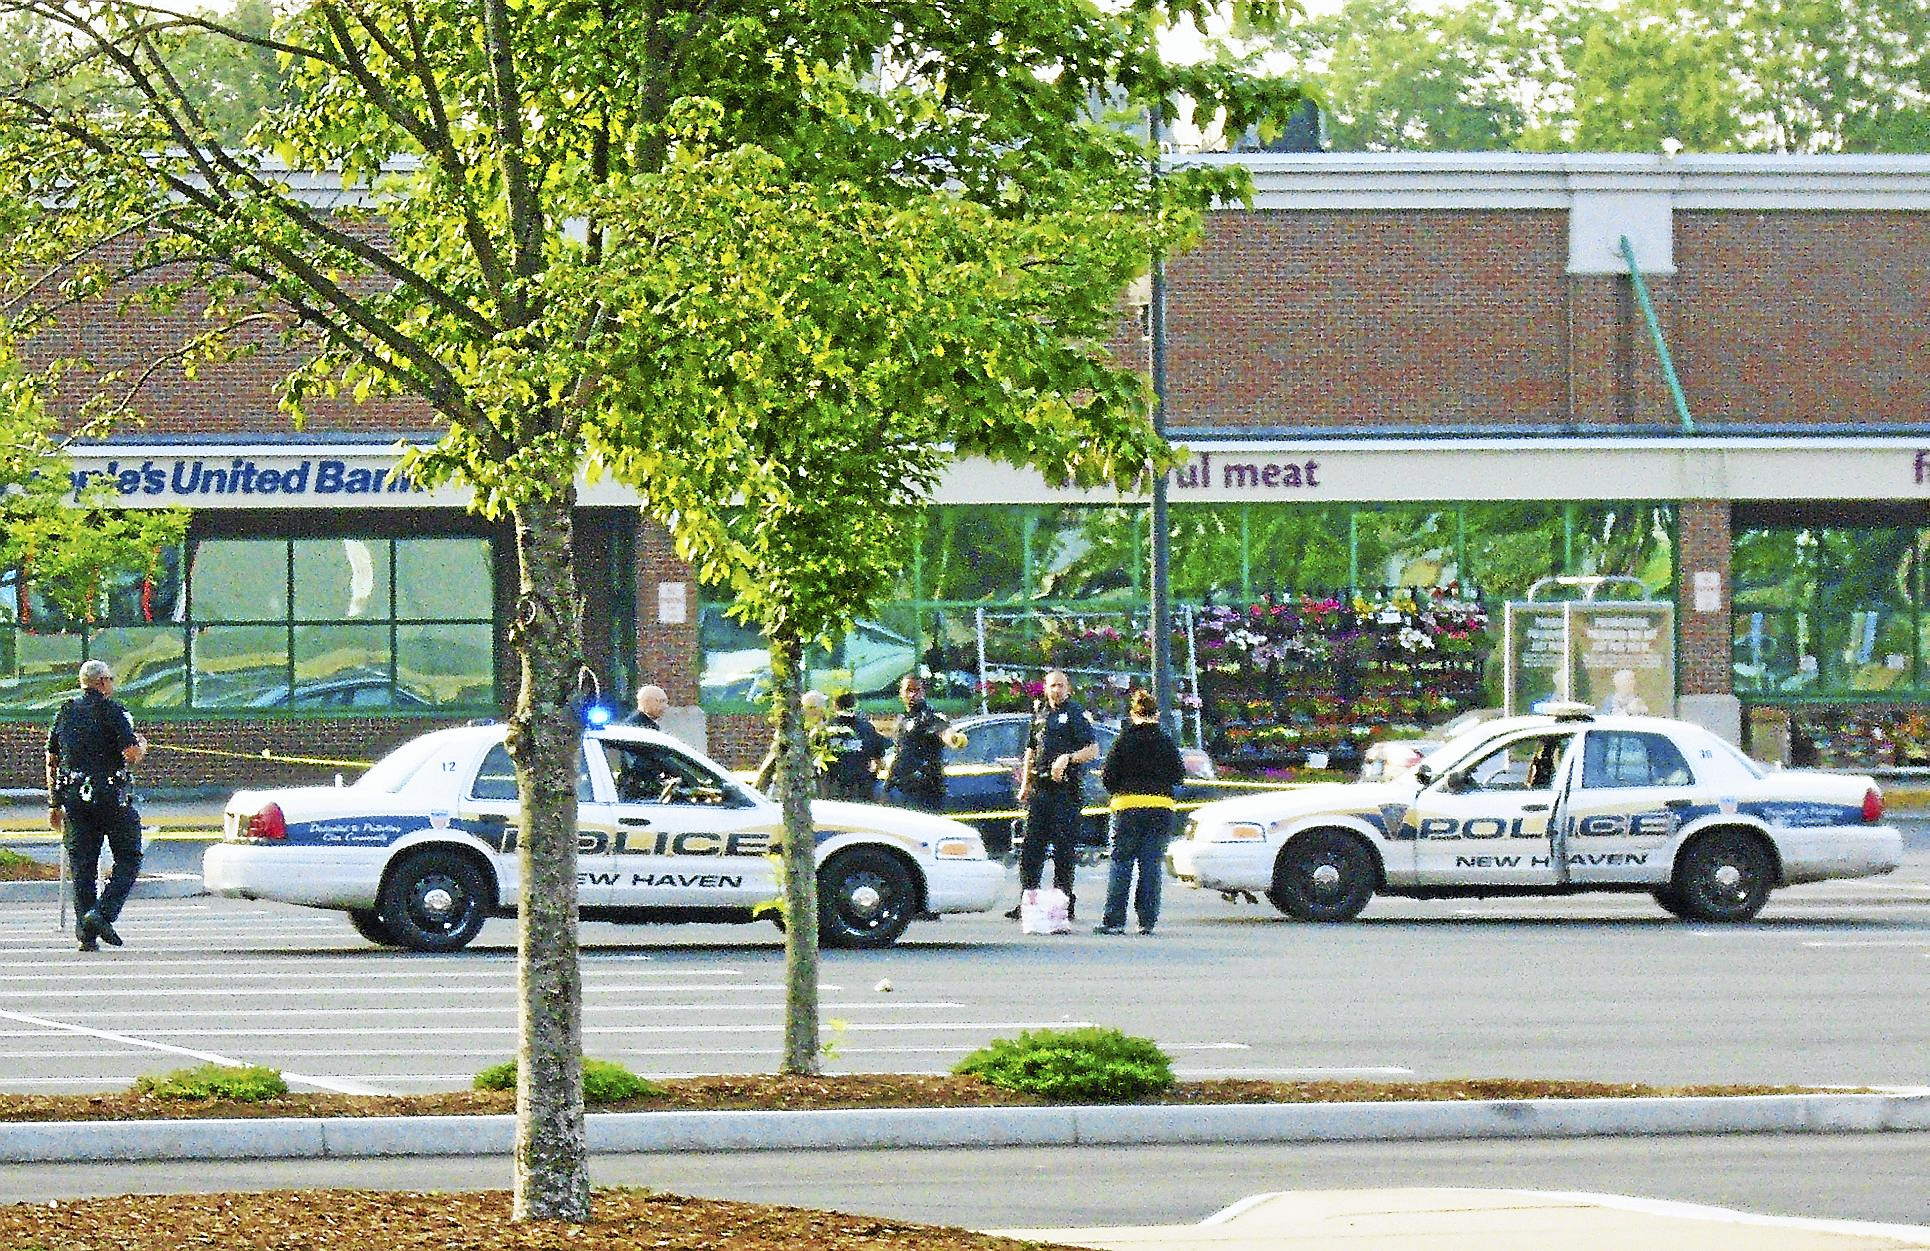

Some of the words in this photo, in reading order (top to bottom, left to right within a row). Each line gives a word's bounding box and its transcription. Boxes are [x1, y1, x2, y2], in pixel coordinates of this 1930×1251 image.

[170, 459, 312, 495] United
[1223, 459, 1321, 488] meat
[442, 761, 456, 772] 12
[1455, 855, 1521, 868] NEW
[1531, 853, 1648, 868] HAVEN
[576, 872, 620, 886] EW
[632, 873, 743, 888] HAVEN
